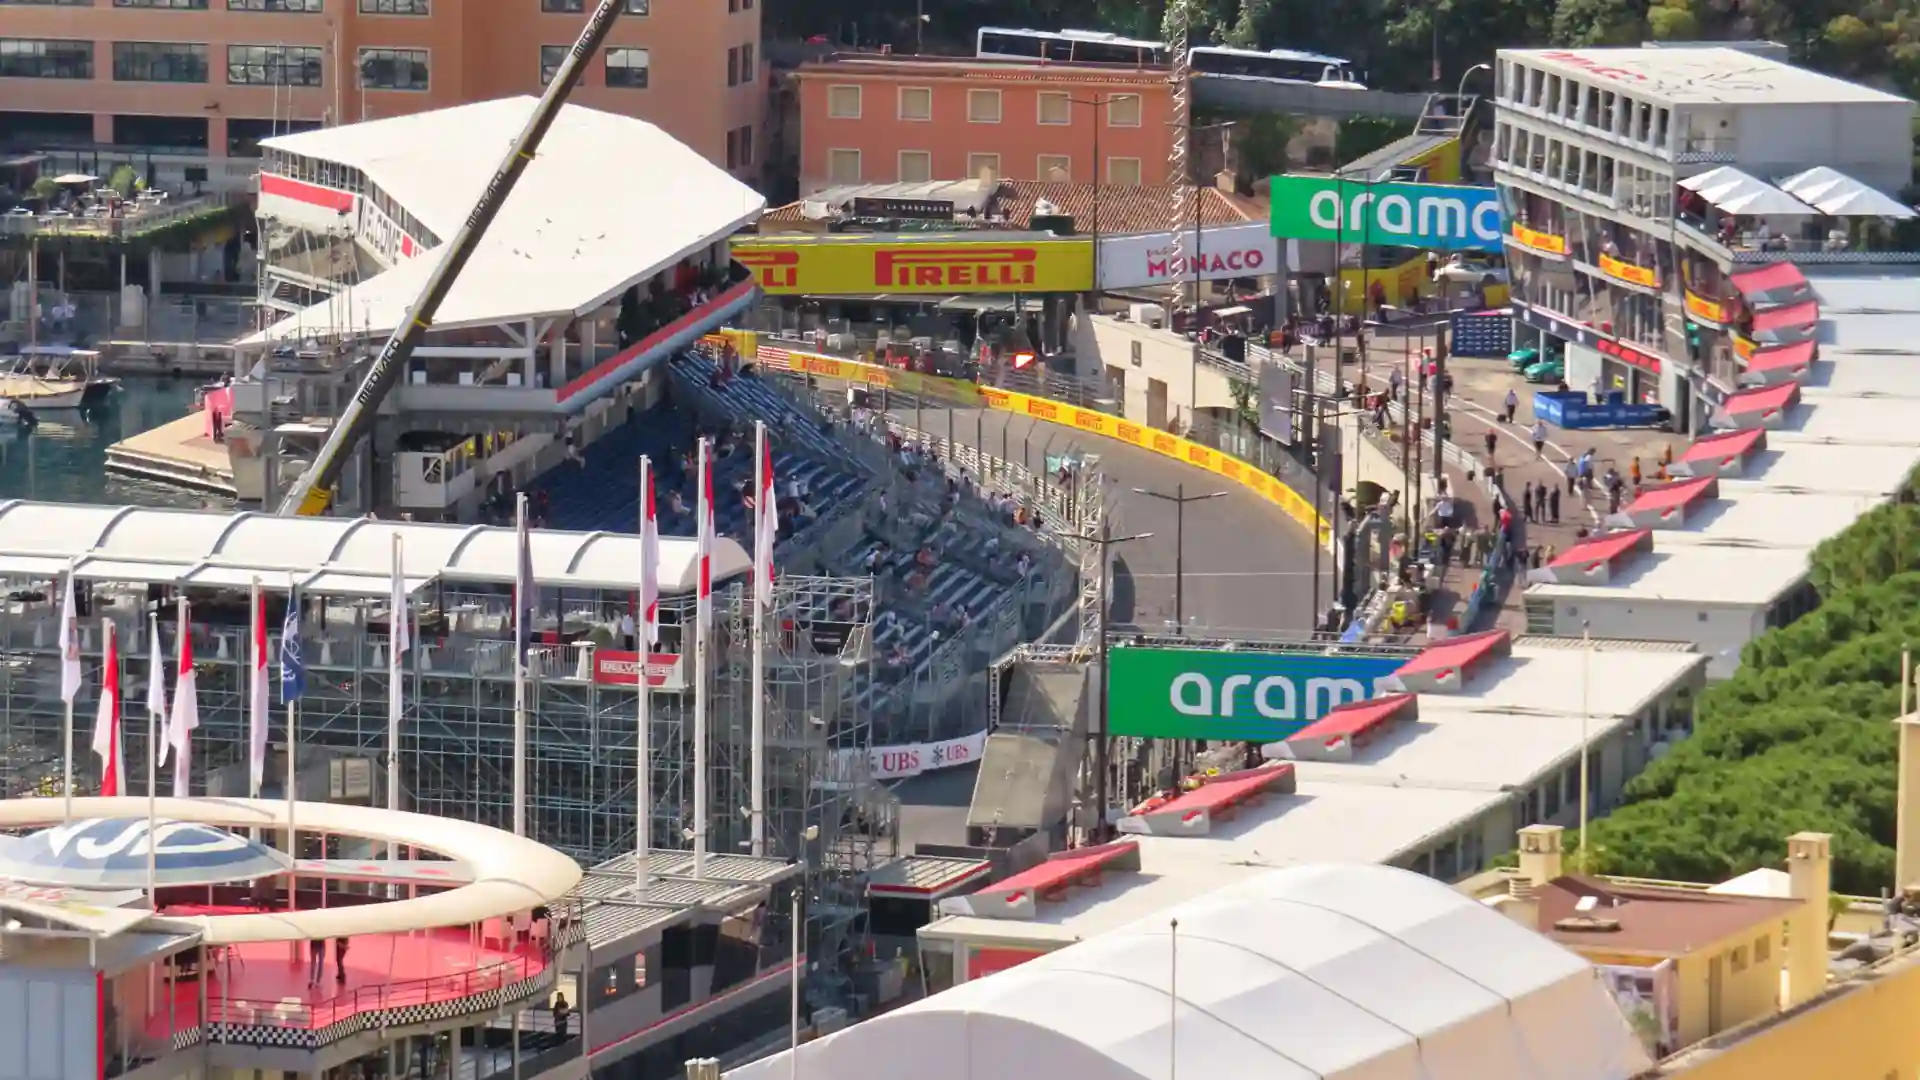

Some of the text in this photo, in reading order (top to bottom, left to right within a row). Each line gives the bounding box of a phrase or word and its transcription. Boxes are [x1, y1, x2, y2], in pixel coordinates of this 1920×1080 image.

[1309, 190, 1502, 241] aramc
[875, 249, 1036, 286] PIRELLI
[1147, 249, 1264, 278] MONACO
[1170, 672, 1365, 720] aram
[882, 744, 969, 772] UBS UBS
